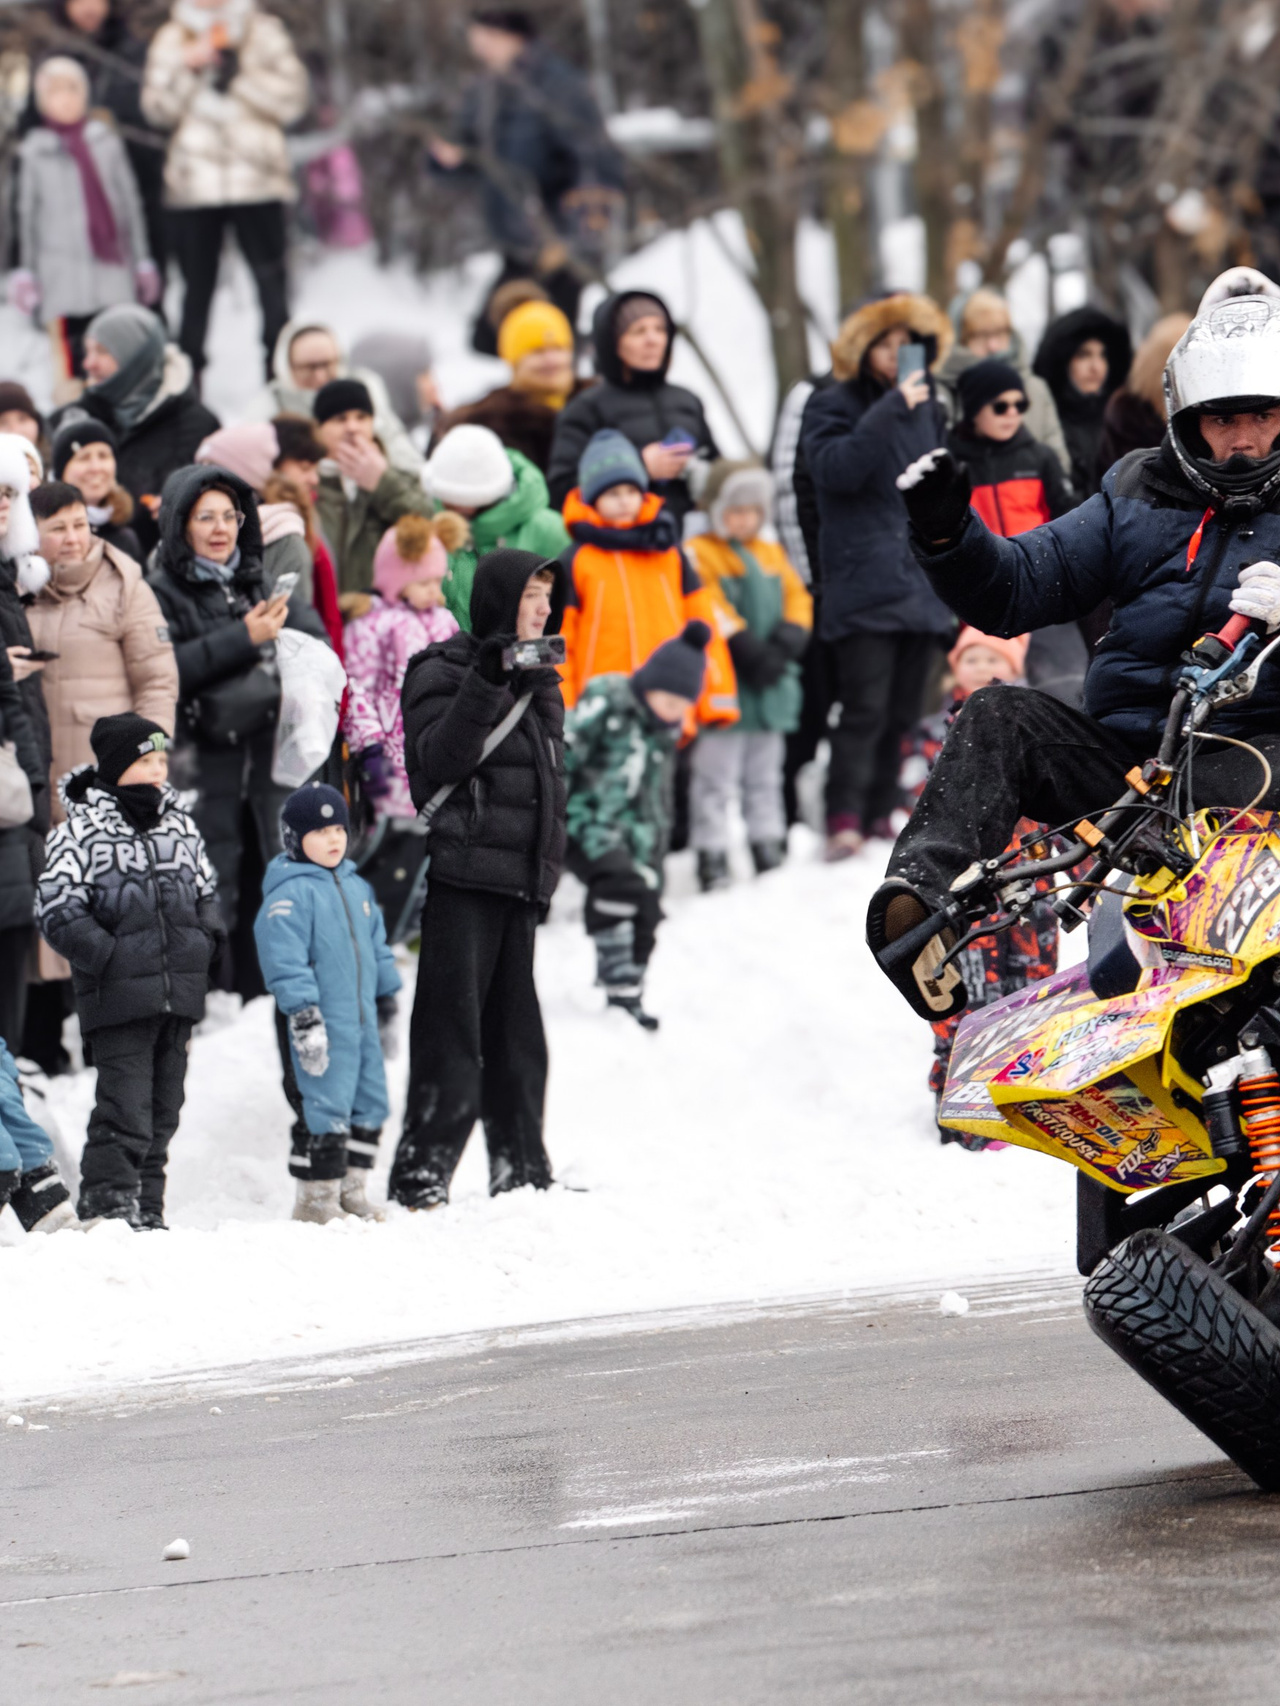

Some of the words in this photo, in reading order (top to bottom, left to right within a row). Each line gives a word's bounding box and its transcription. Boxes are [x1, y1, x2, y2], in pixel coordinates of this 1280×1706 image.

[952, 988, 1070, 1079] 228
[1053, 1017, 1099, 1051] FOX
[1022, 1101, 1101, 1161] FASTHOUSE
[1063, 1101, 1129, 1147] AMSOIL
[1116, 1144, 1146, 1180] FOX
[1151, 1145, 1180, 1180] GAV
